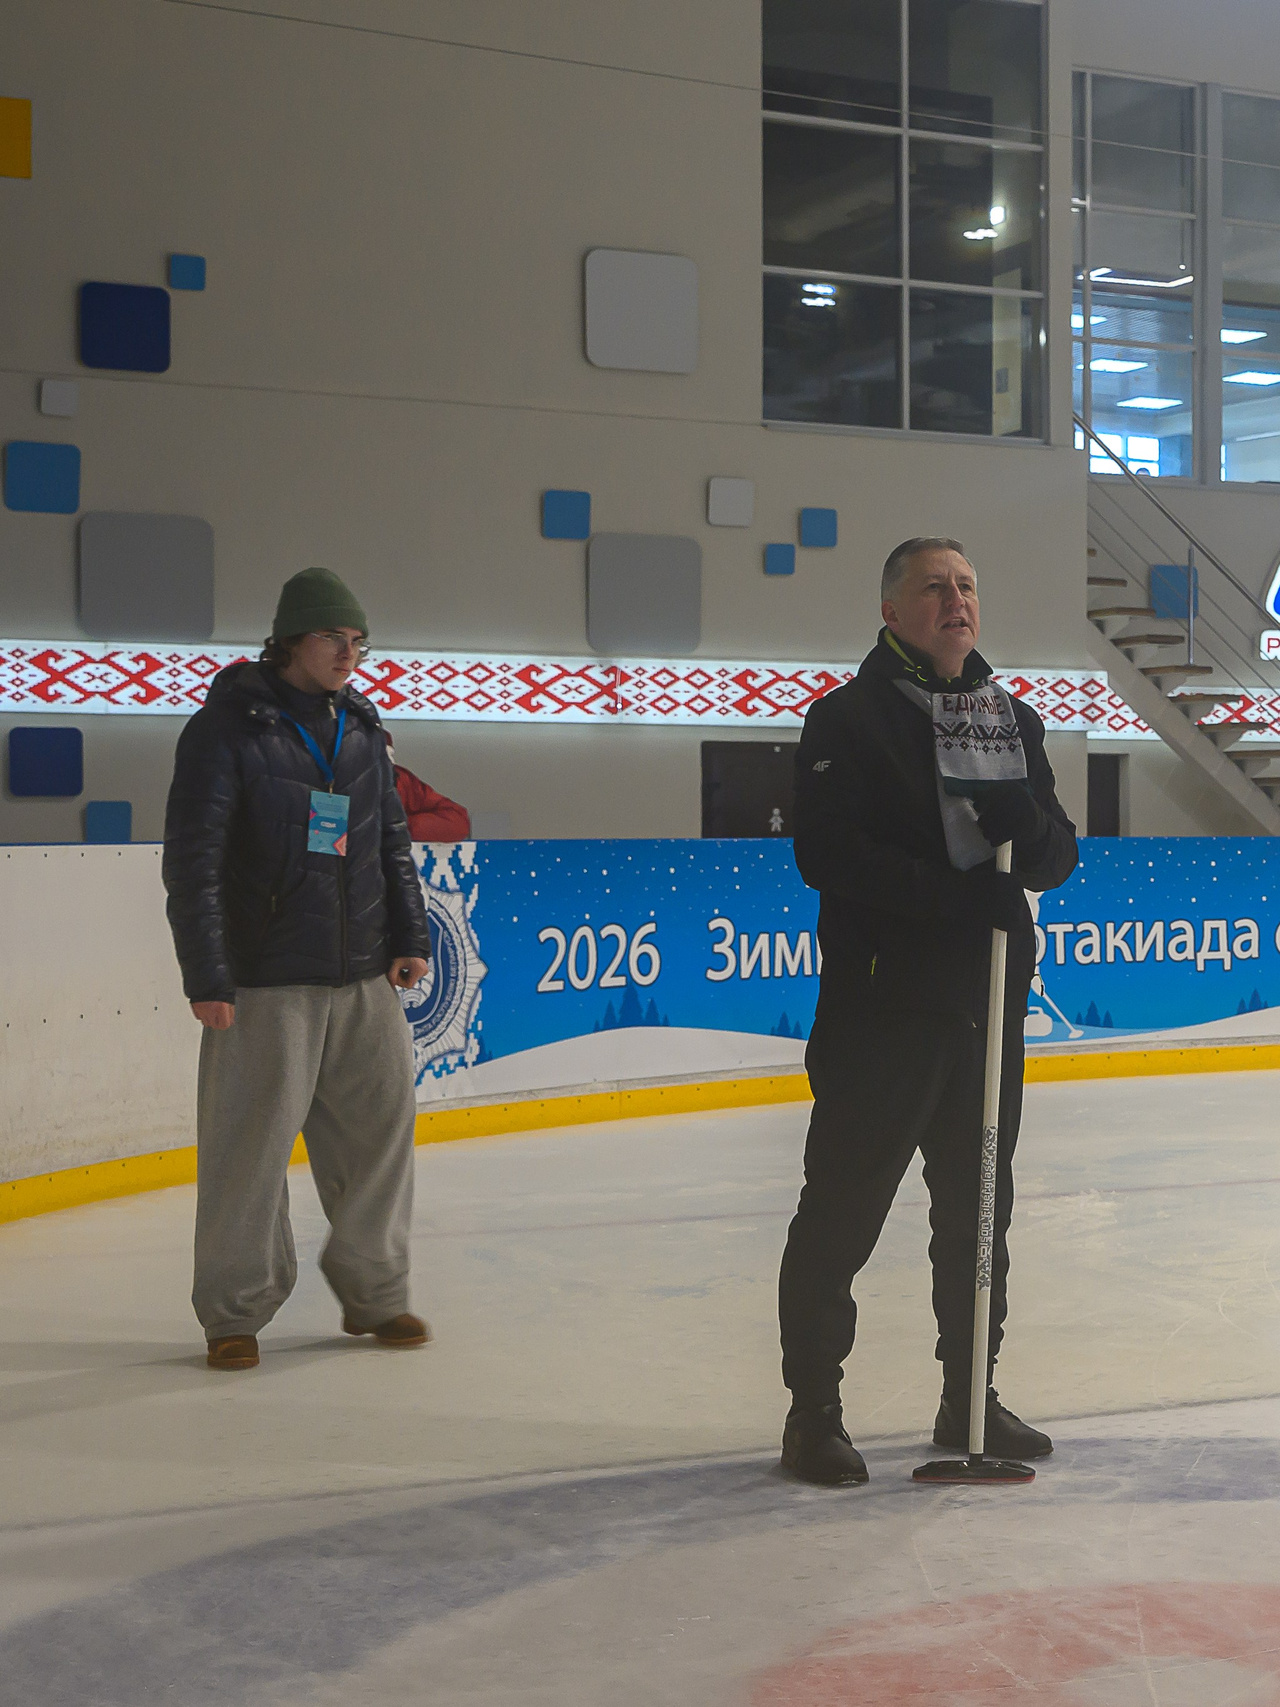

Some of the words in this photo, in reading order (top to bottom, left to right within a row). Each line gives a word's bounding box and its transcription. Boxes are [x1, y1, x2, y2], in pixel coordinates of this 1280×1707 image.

[812, 760, 831, 772] 4F
[537, 922, 661, 993] 2026
[705, 917, 823, 981] Зим
[980, 1158, 993, 1218] Fiberglass
[979, 1222, 991, 1257] Olson
